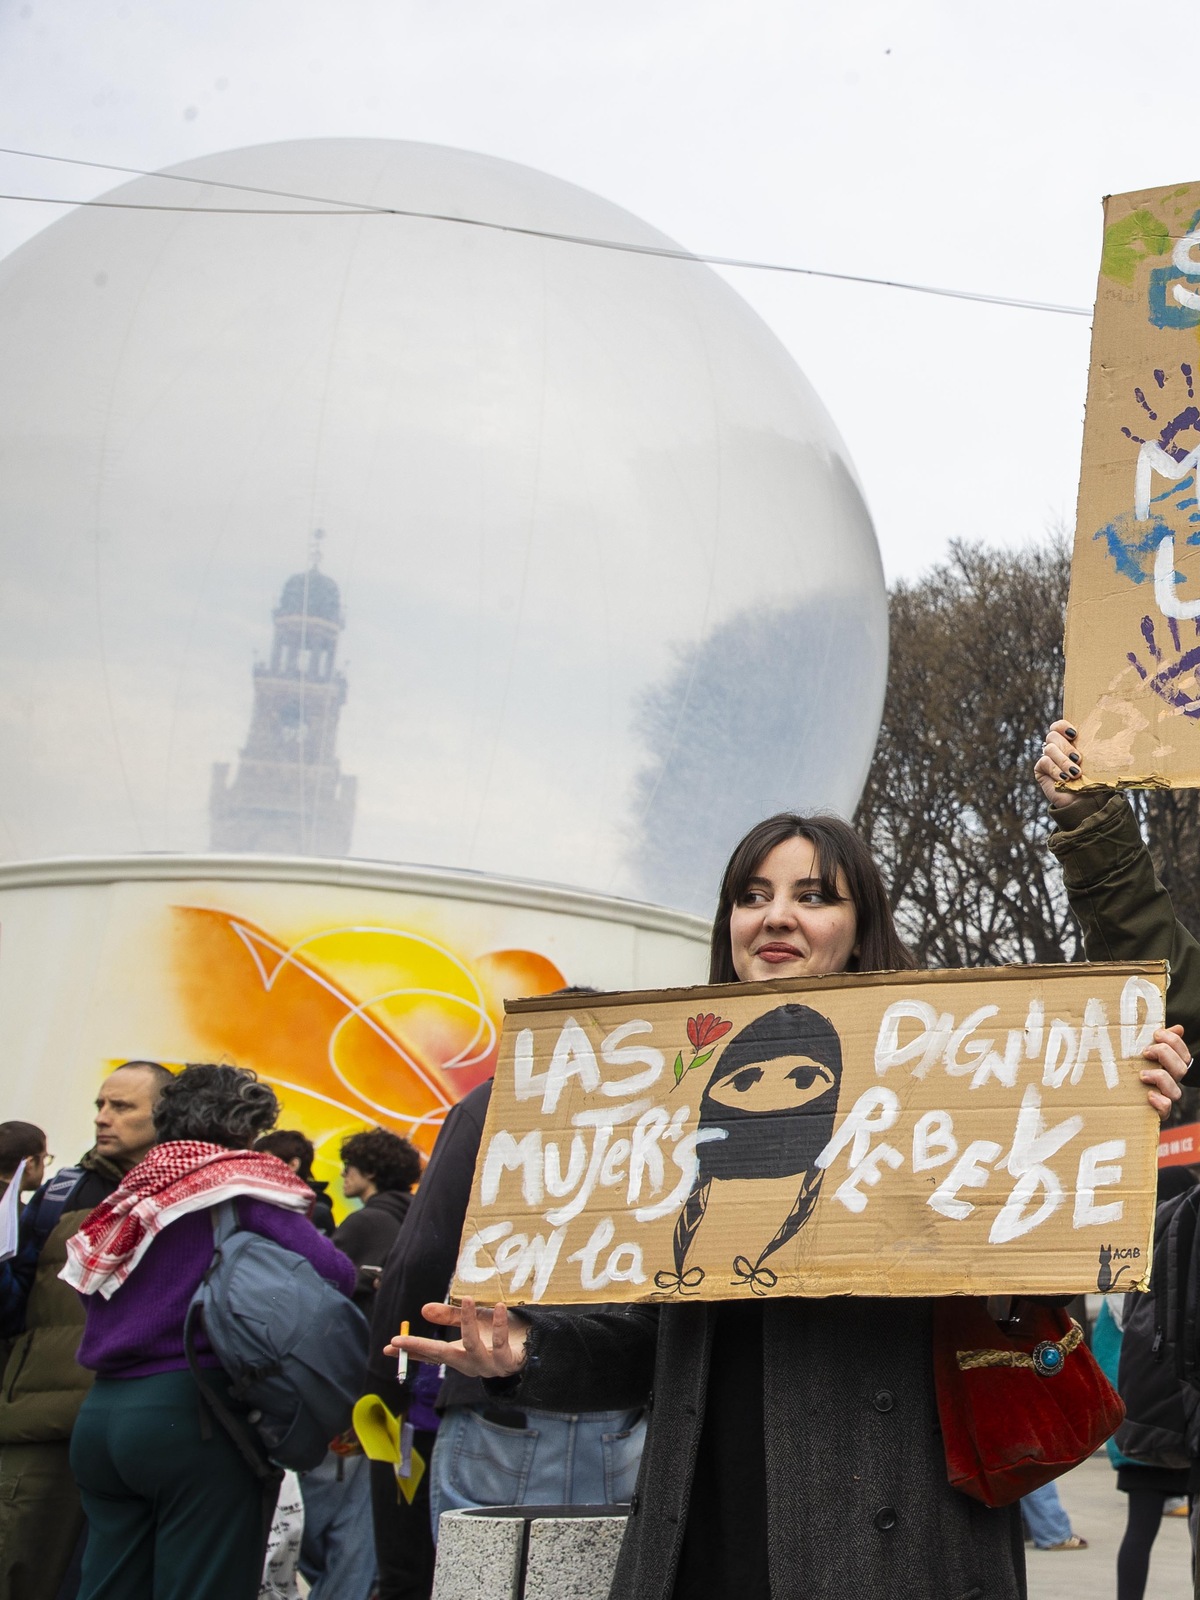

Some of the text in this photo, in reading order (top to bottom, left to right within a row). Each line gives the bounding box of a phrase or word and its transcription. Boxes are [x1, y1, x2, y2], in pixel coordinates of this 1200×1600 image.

[514, 1016, 665, 1115] LAS
[874, 976, 1163, 1090] DIGNIDAD
[566, 1216, 648, 1291] la
[1113, 1247, 1141, 1260] ACAB
